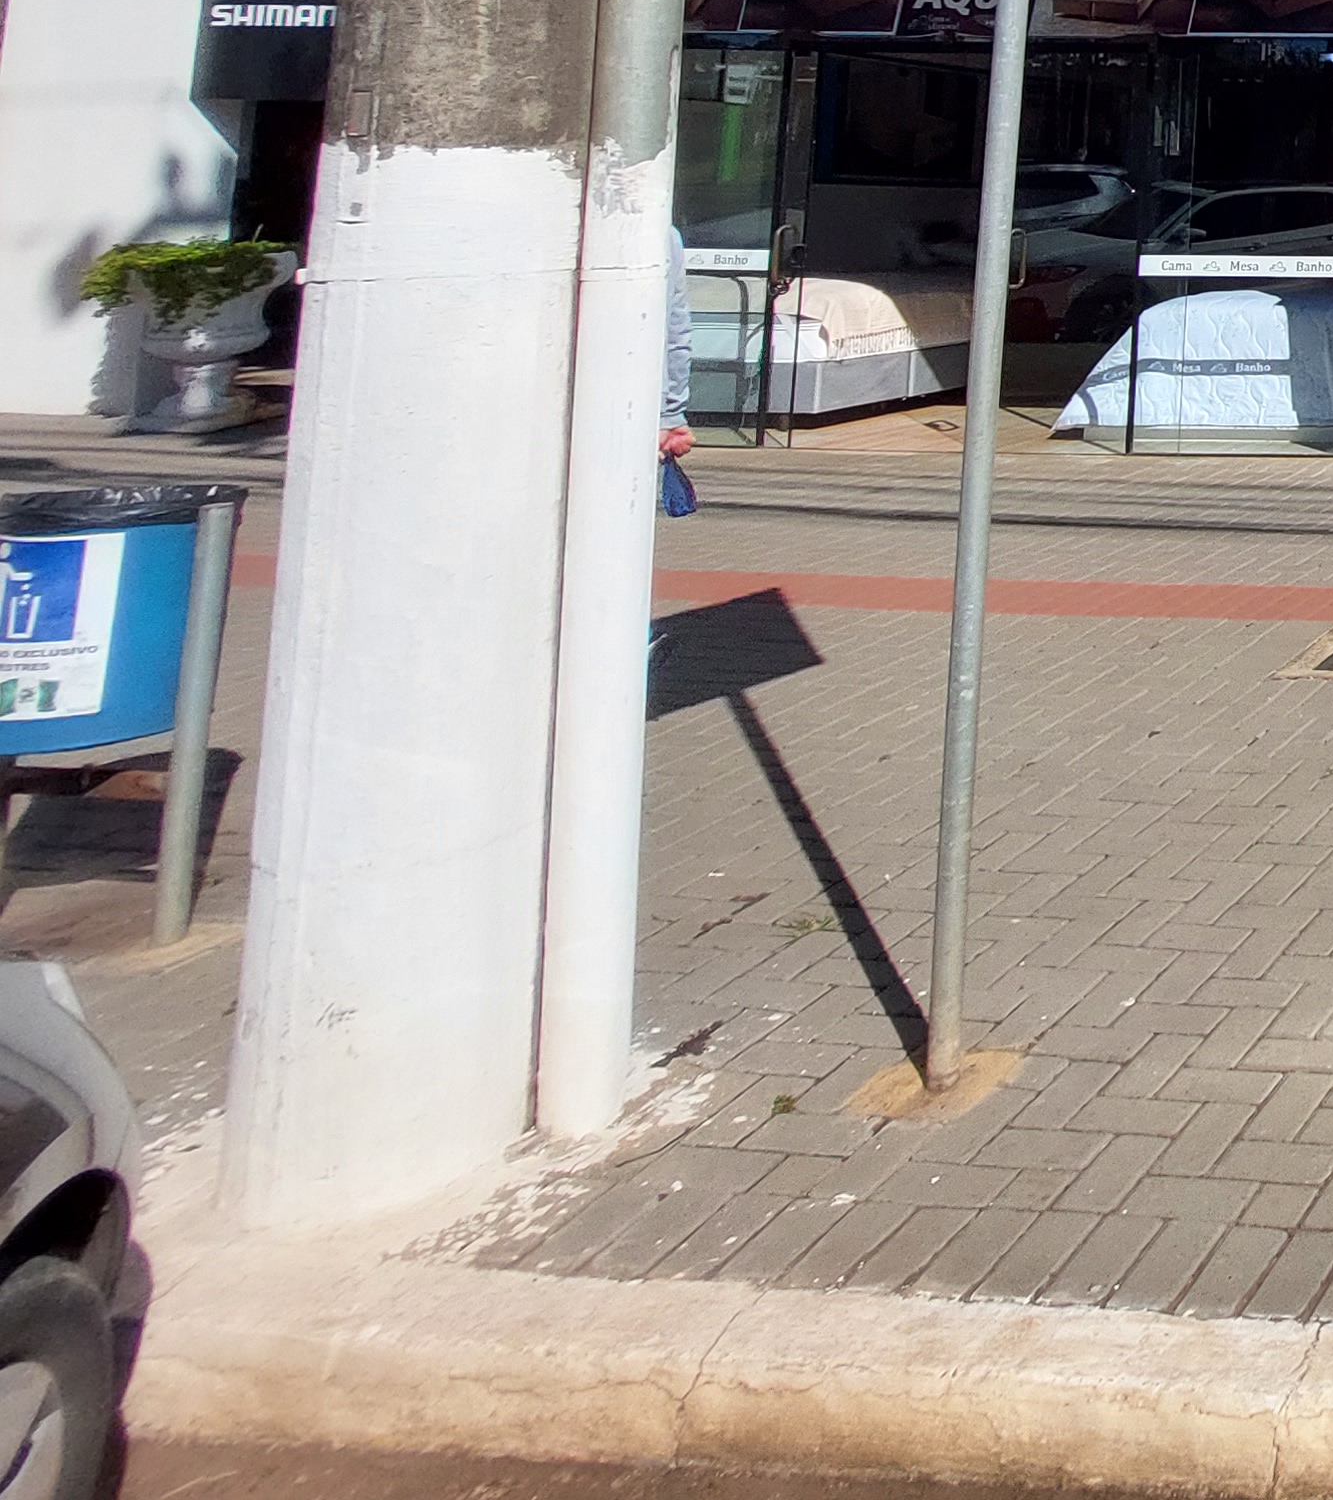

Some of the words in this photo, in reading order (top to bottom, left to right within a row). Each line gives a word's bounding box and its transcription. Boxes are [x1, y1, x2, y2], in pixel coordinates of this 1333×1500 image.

[210, 5, 338, 27] SHIMAN
[713, 255, 749, 266] Banho
[1161, 260, 1192, 271] Cama
[1230, 260, 1259, 272] Mesa
[1296, 261, 1333, 273] Banho
[1236, 363, 1271, 373] Banho
[13, 645, 98, 659] EXCLUSIVO
